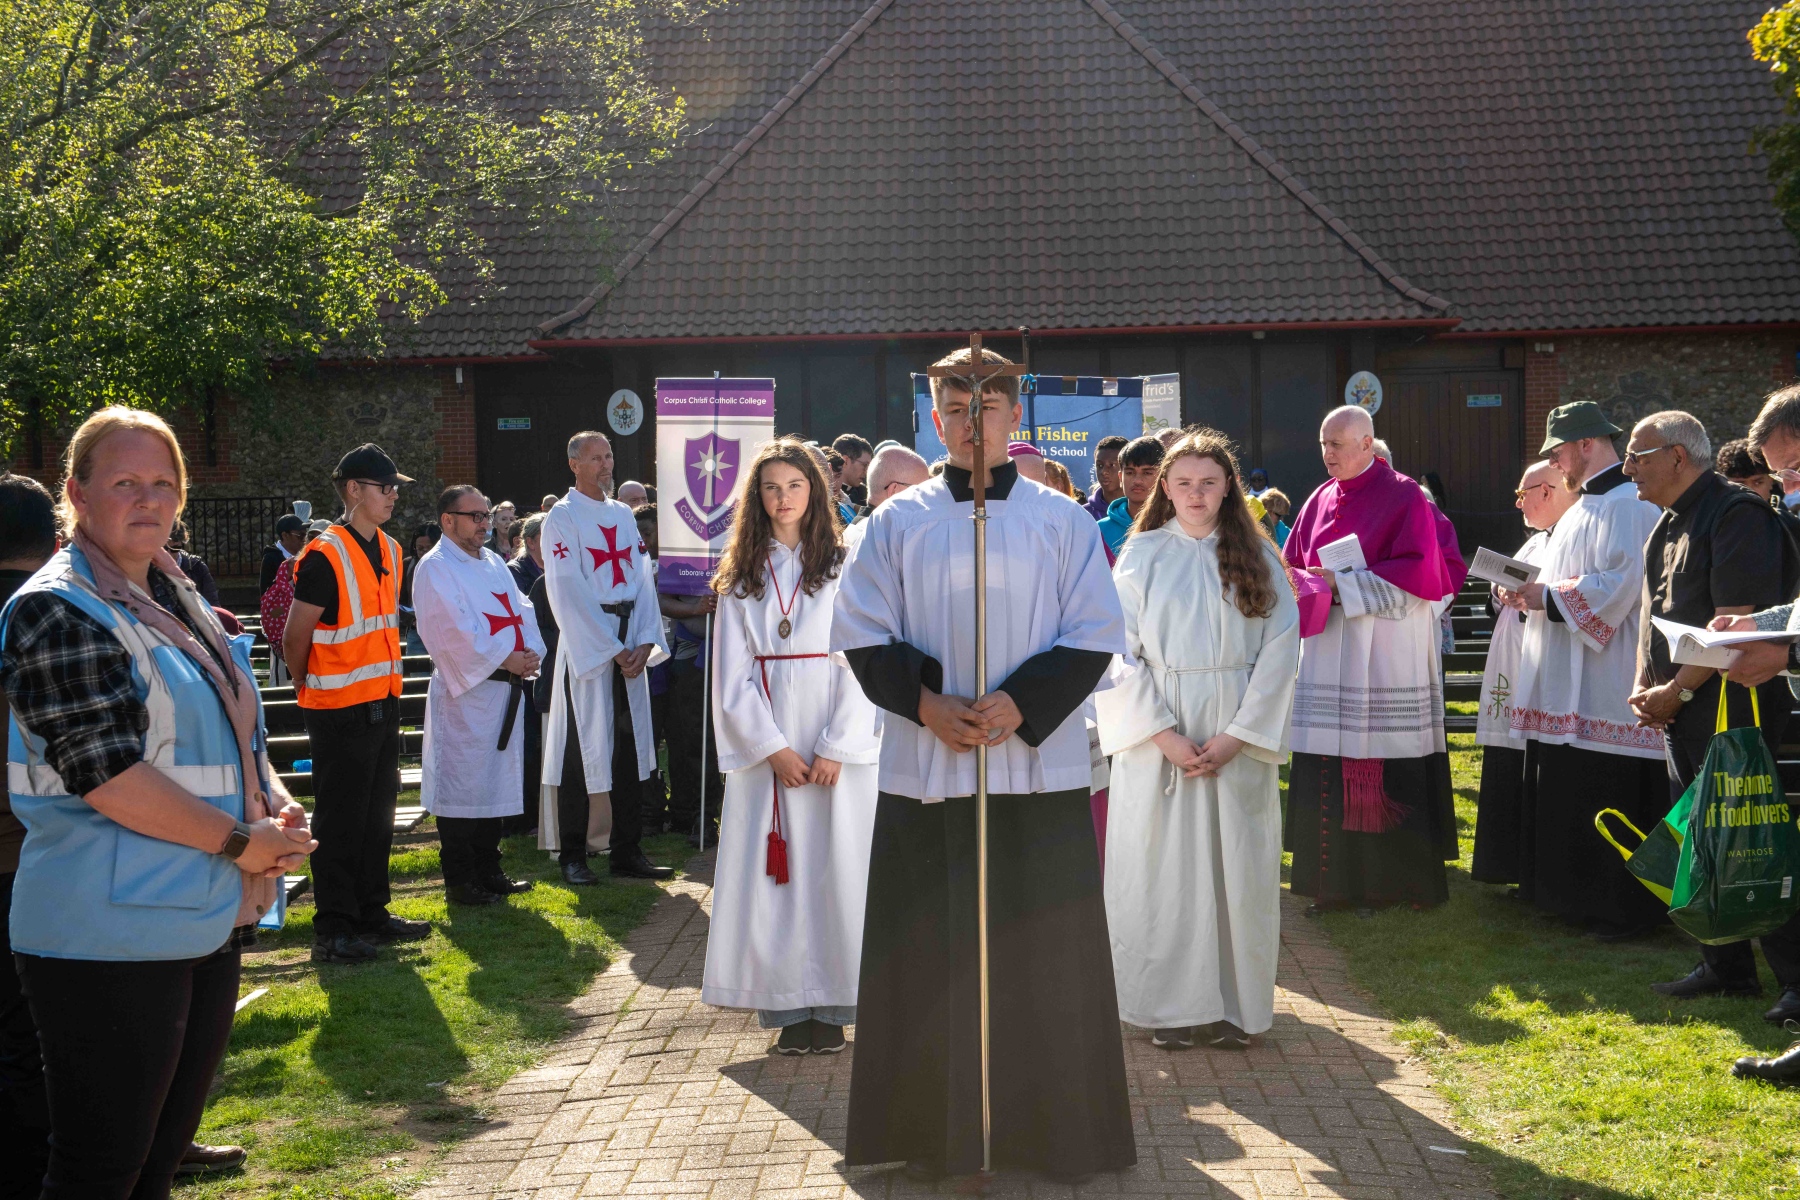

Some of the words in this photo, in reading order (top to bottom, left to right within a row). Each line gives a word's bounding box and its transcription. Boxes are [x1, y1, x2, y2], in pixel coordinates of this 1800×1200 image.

[1145, 383, 1174, 397] frid's
[663, 397, 687, 405] Corpus
[688, 396, 708, 404] Christi
[739, 398, 767, 406] College
[1036, 426, 1089, 441] Fisher
[1050, 446, 1087, 456] School
[680, 505, 704, 533] CORPUS
[1714, 771, 1743, 797] The
[1720, 801, 1750, 828] food
[1752, 801, 1790, 825] lovers
[1727, 847, 1774, 858] WAITROSE
